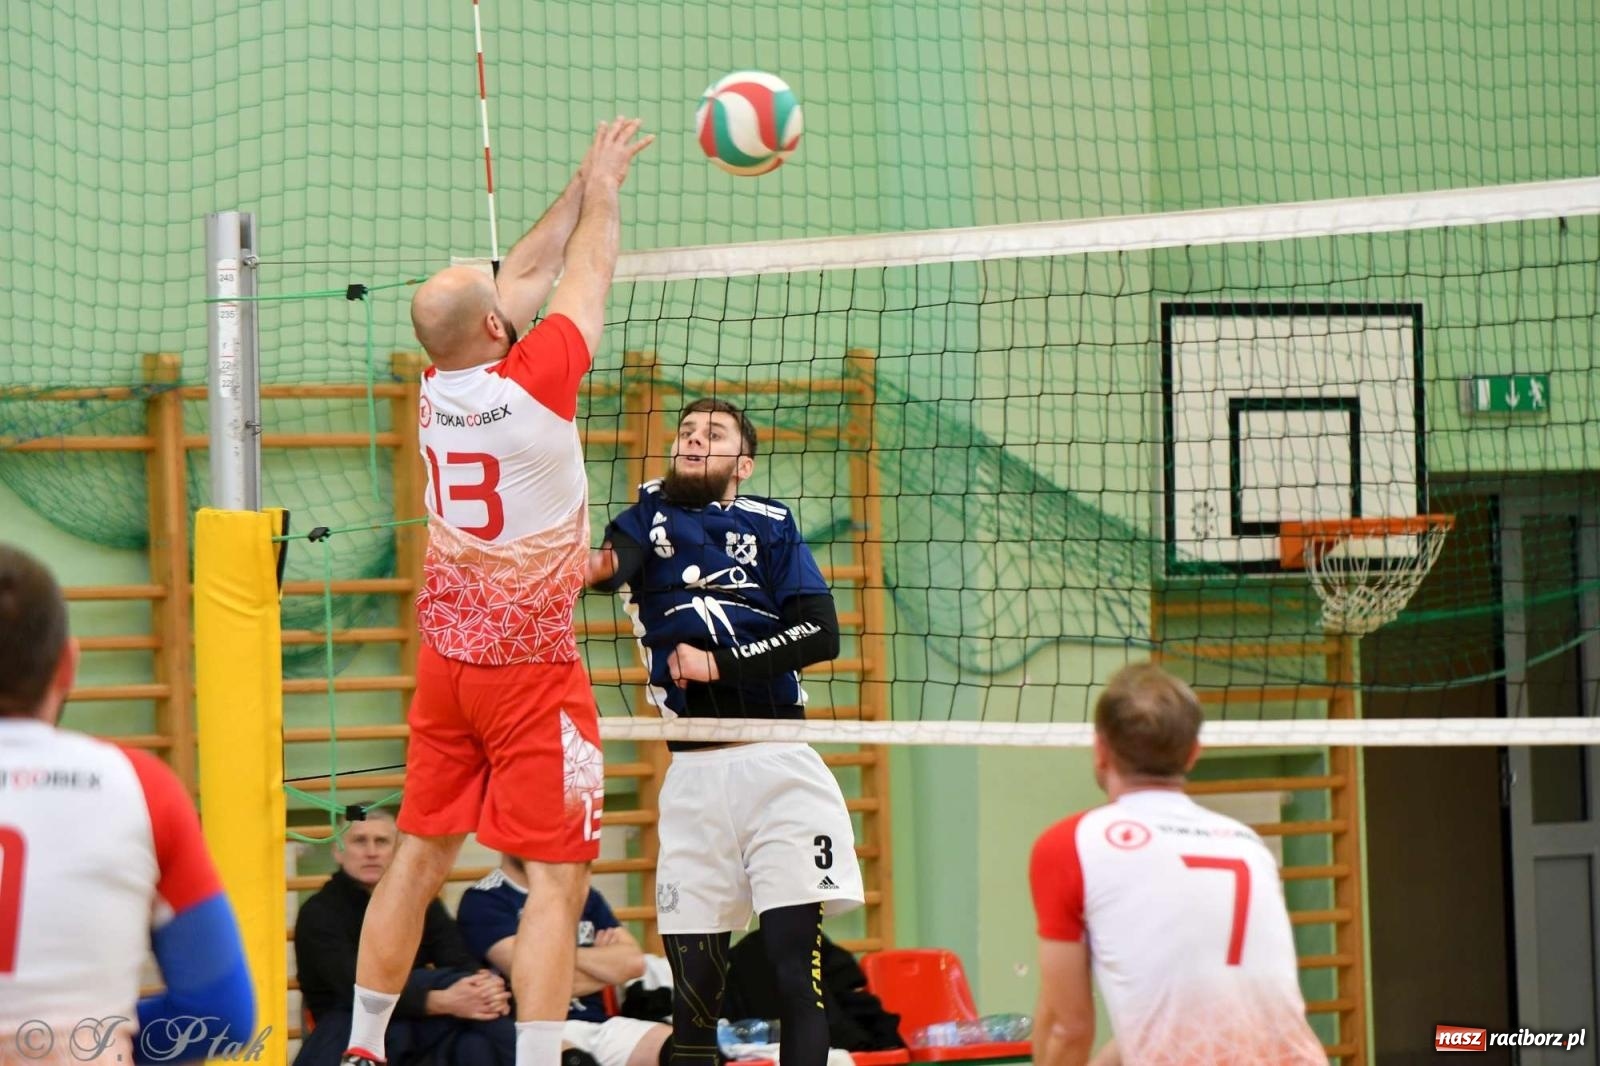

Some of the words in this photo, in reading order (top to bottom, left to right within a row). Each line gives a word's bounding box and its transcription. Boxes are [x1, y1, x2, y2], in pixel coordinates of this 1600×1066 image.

[435, 411, 465, 428] TOKAI
[466, 403, 513, 428] COBEX
[426, 445, 504, 541] 13
[740, 640, 771, 658] CAN
[784, 621, 822, 642] WILL
[814, 834, 834, 870] 3
[1181, 855, 1252, 966] 7
